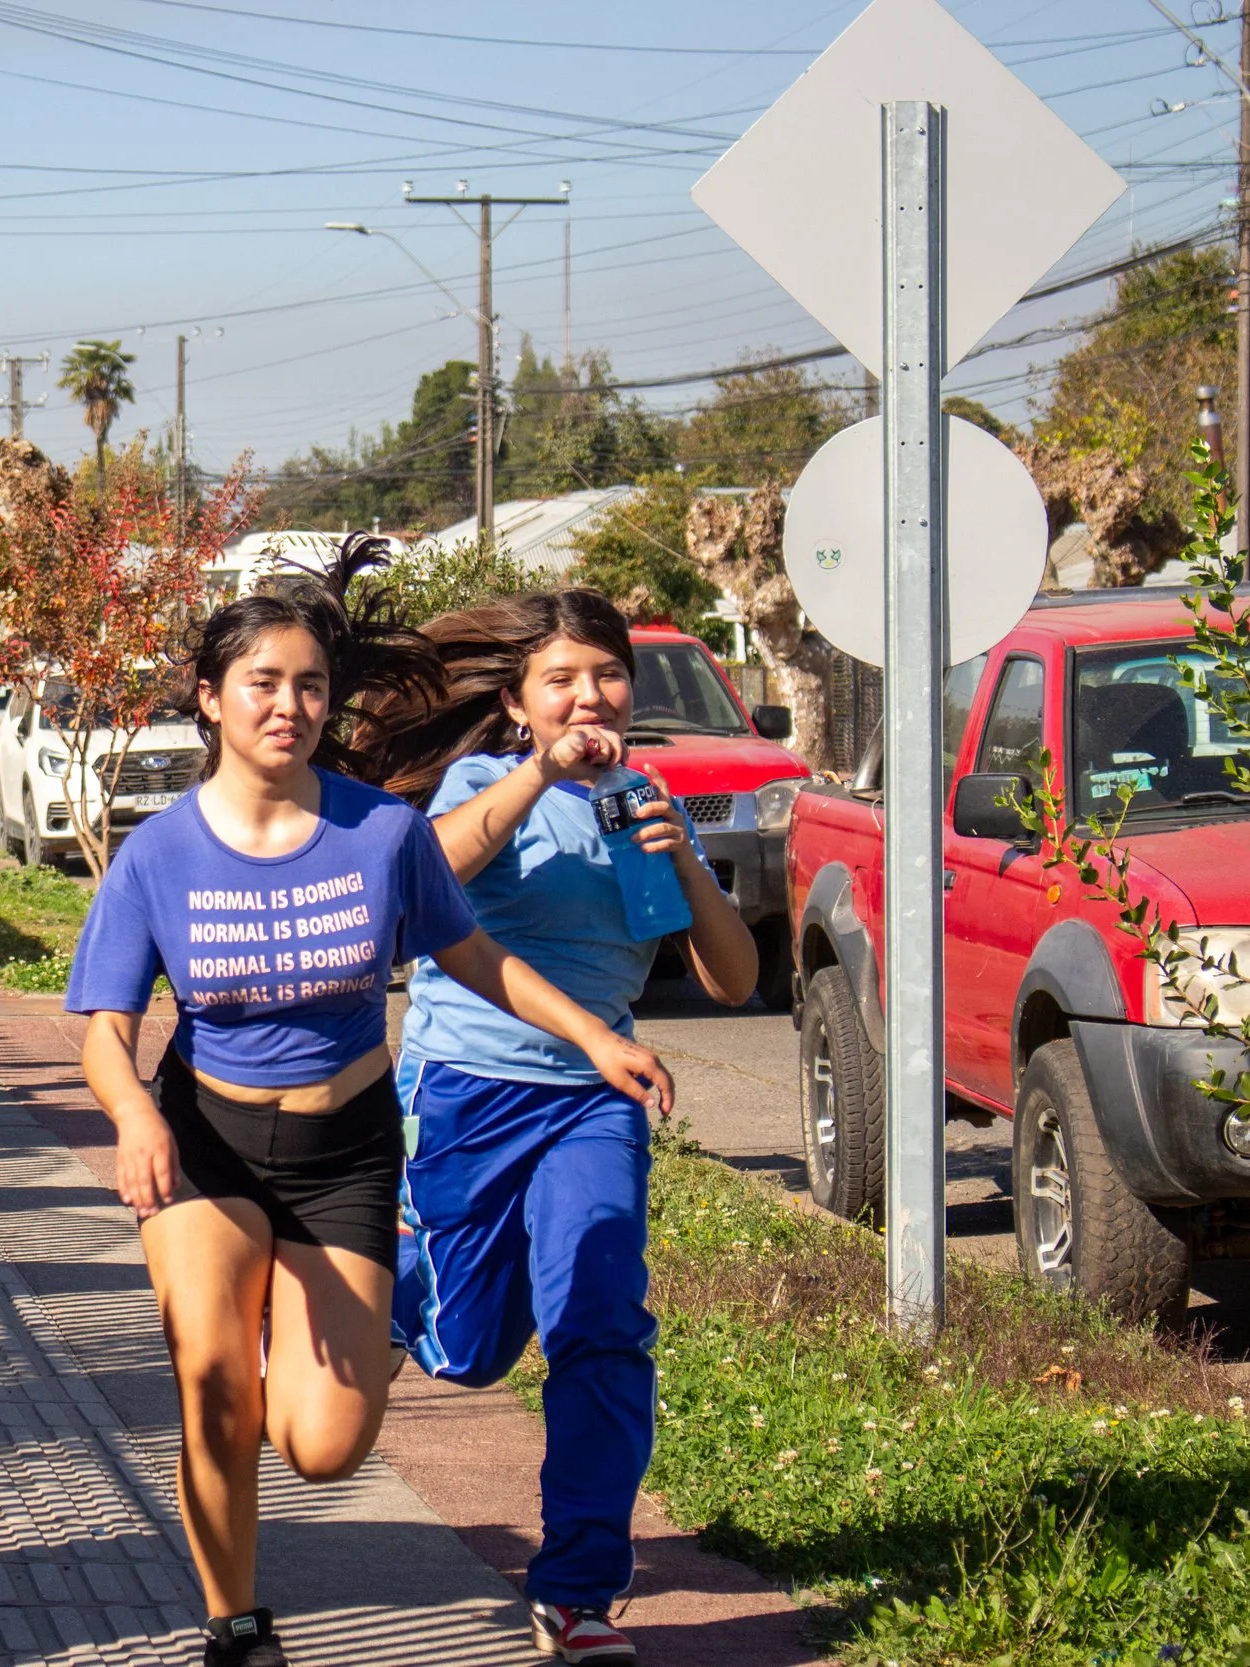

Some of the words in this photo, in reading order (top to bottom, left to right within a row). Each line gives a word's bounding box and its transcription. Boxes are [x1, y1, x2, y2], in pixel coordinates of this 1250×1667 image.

[189, 891, 266, 910] NORMAL
[271, 890, 288, 909] IS
[292, 872, 364, 907] BORING!
[190, 923, 269, 943] NORMAL
[274, 921, 291, 940] IS
[296, 905, 370, 938] BORING!
[189, 955, 271, 979] NORMAL
[276, 952, 295, 972] IS
[300, 940, 376, 969] BORING!
[192, 986, 272, 1007] NORMAL
[278, 984, 296, 1001] IS
[301, 974, 375, 999] BORING!
